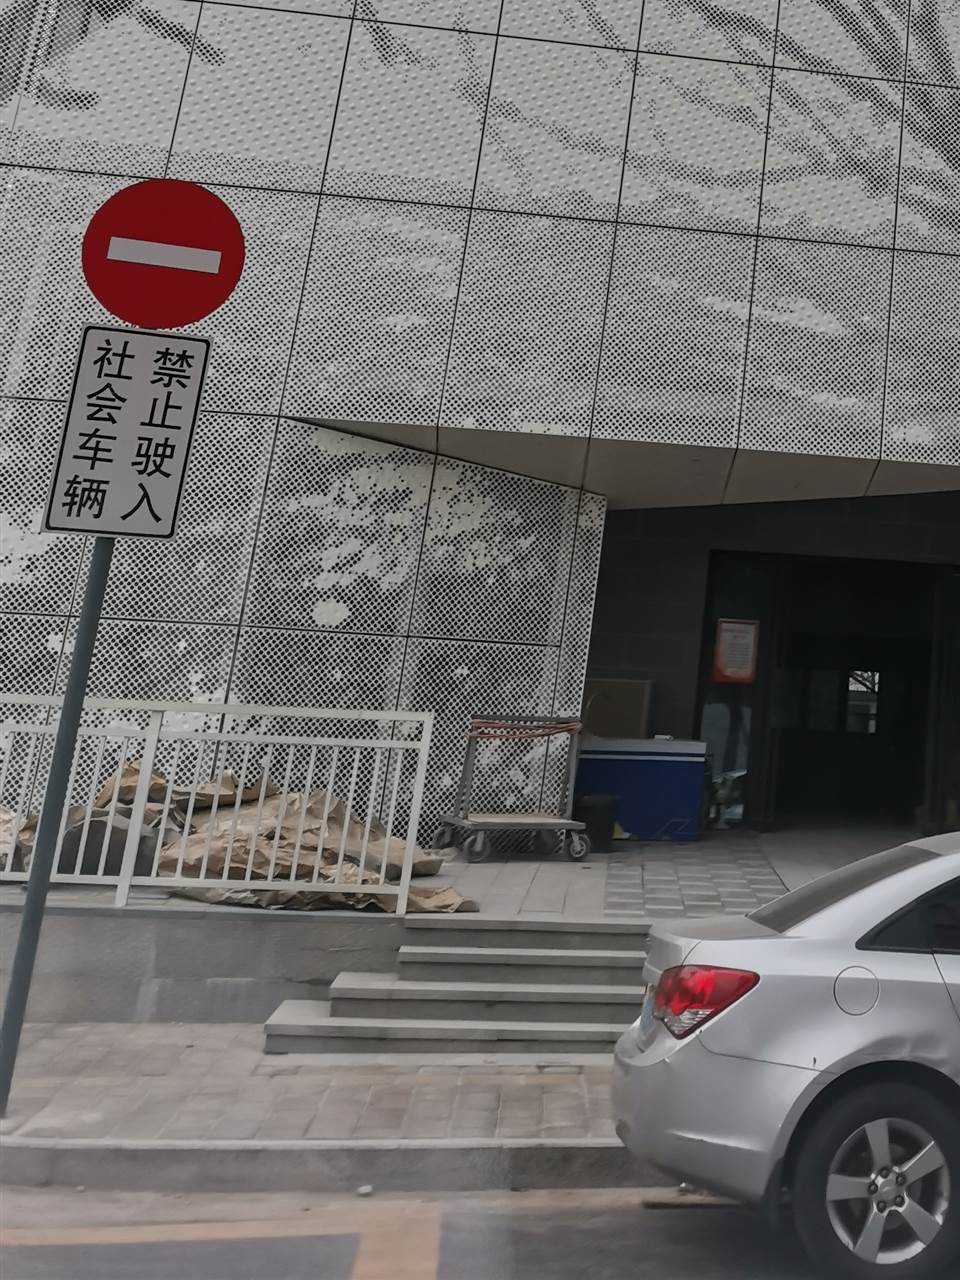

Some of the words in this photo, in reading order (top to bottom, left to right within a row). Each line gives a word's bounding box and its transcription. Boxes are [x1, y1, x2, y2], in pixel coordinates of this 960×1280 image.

[62, 338, 136, 519] 社会车辆
[121, 347, 195, 523] 禁止驶入
